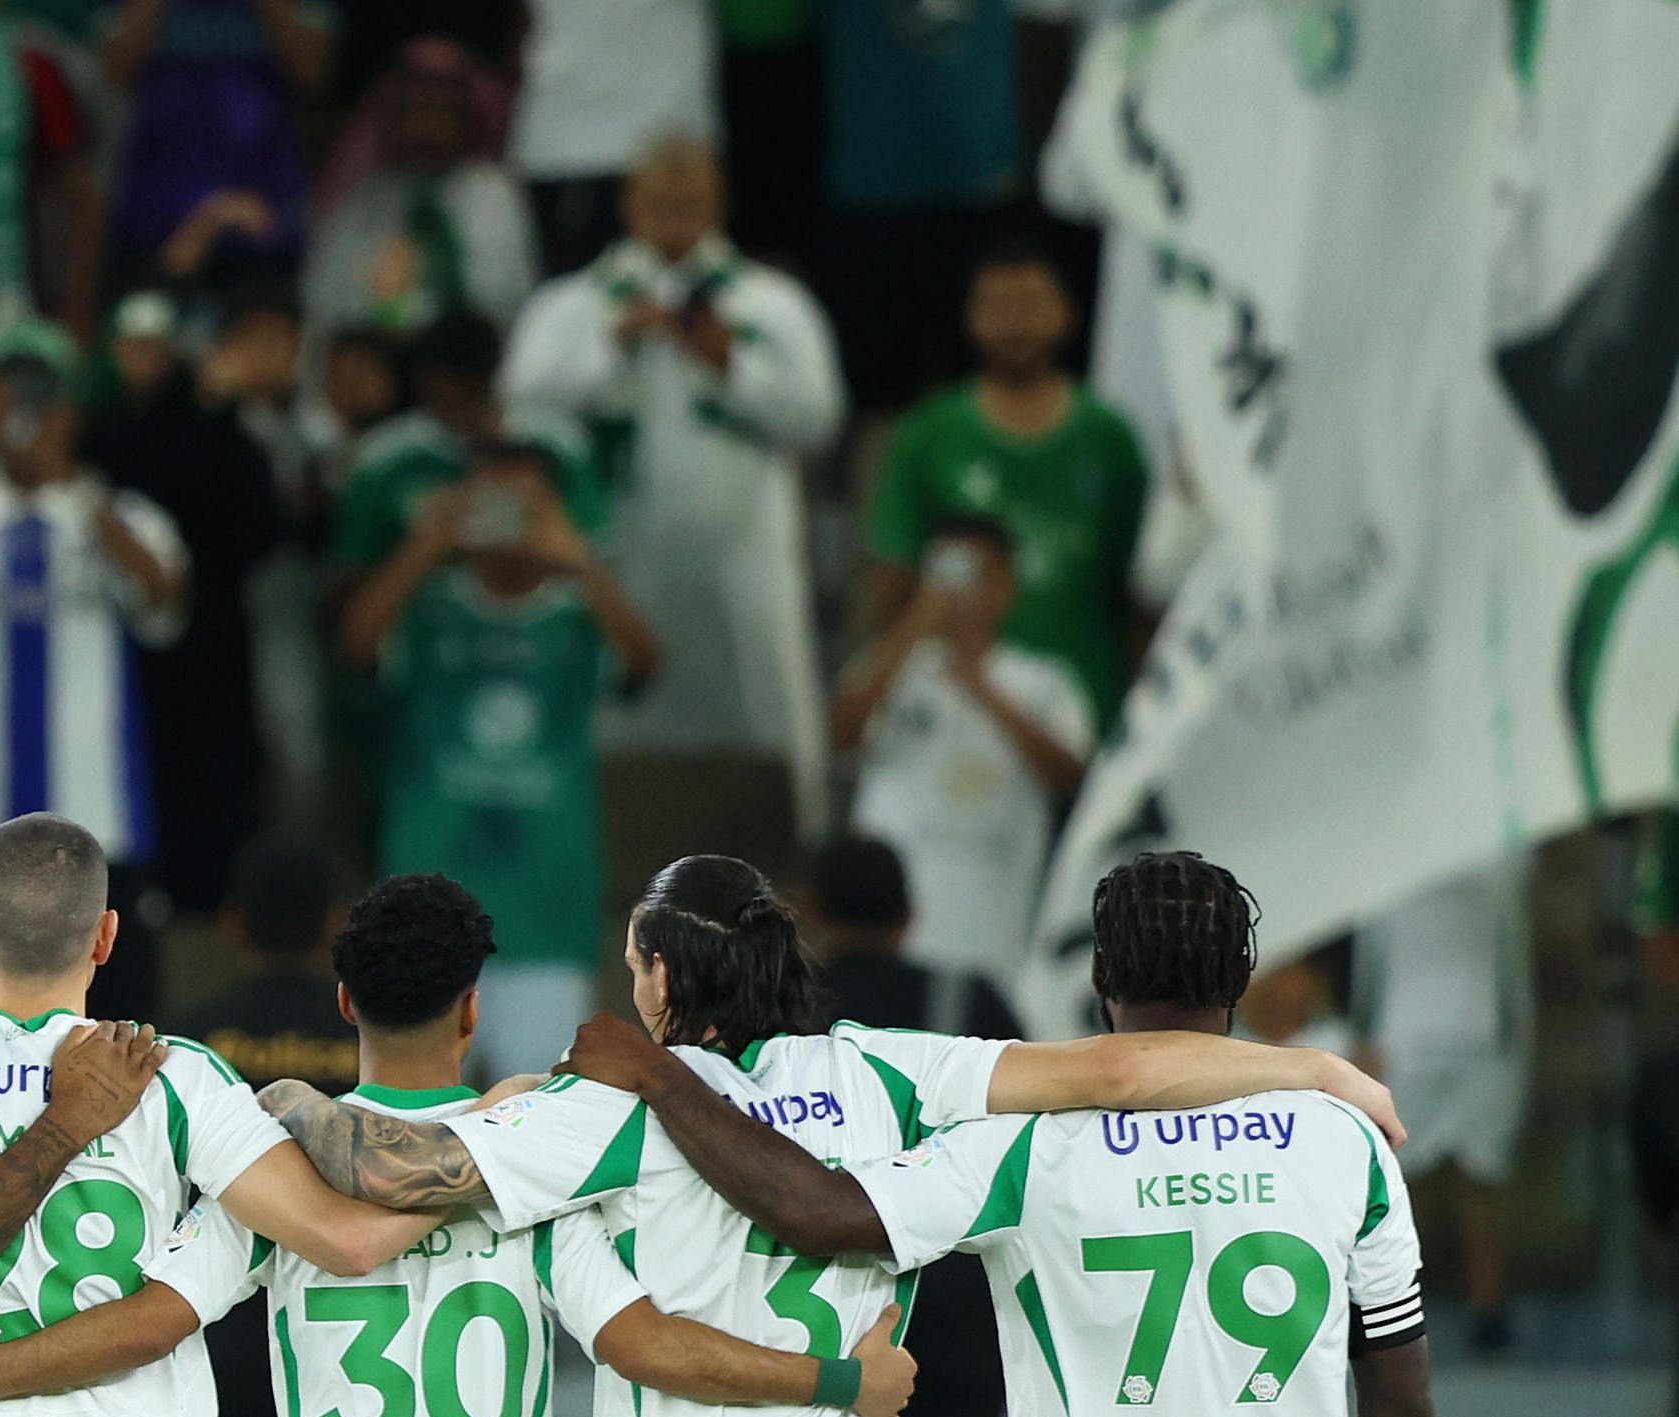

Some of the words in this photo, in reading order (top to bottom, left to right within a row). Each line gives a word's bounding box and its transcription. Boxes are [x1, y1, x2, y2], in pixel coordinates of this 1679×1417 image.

[1154, 1112, 1296, 1151] urpay
[1135, 1172, 1276, 1209] KESSIE
[1080, 1230, 1331, 1406] 79
